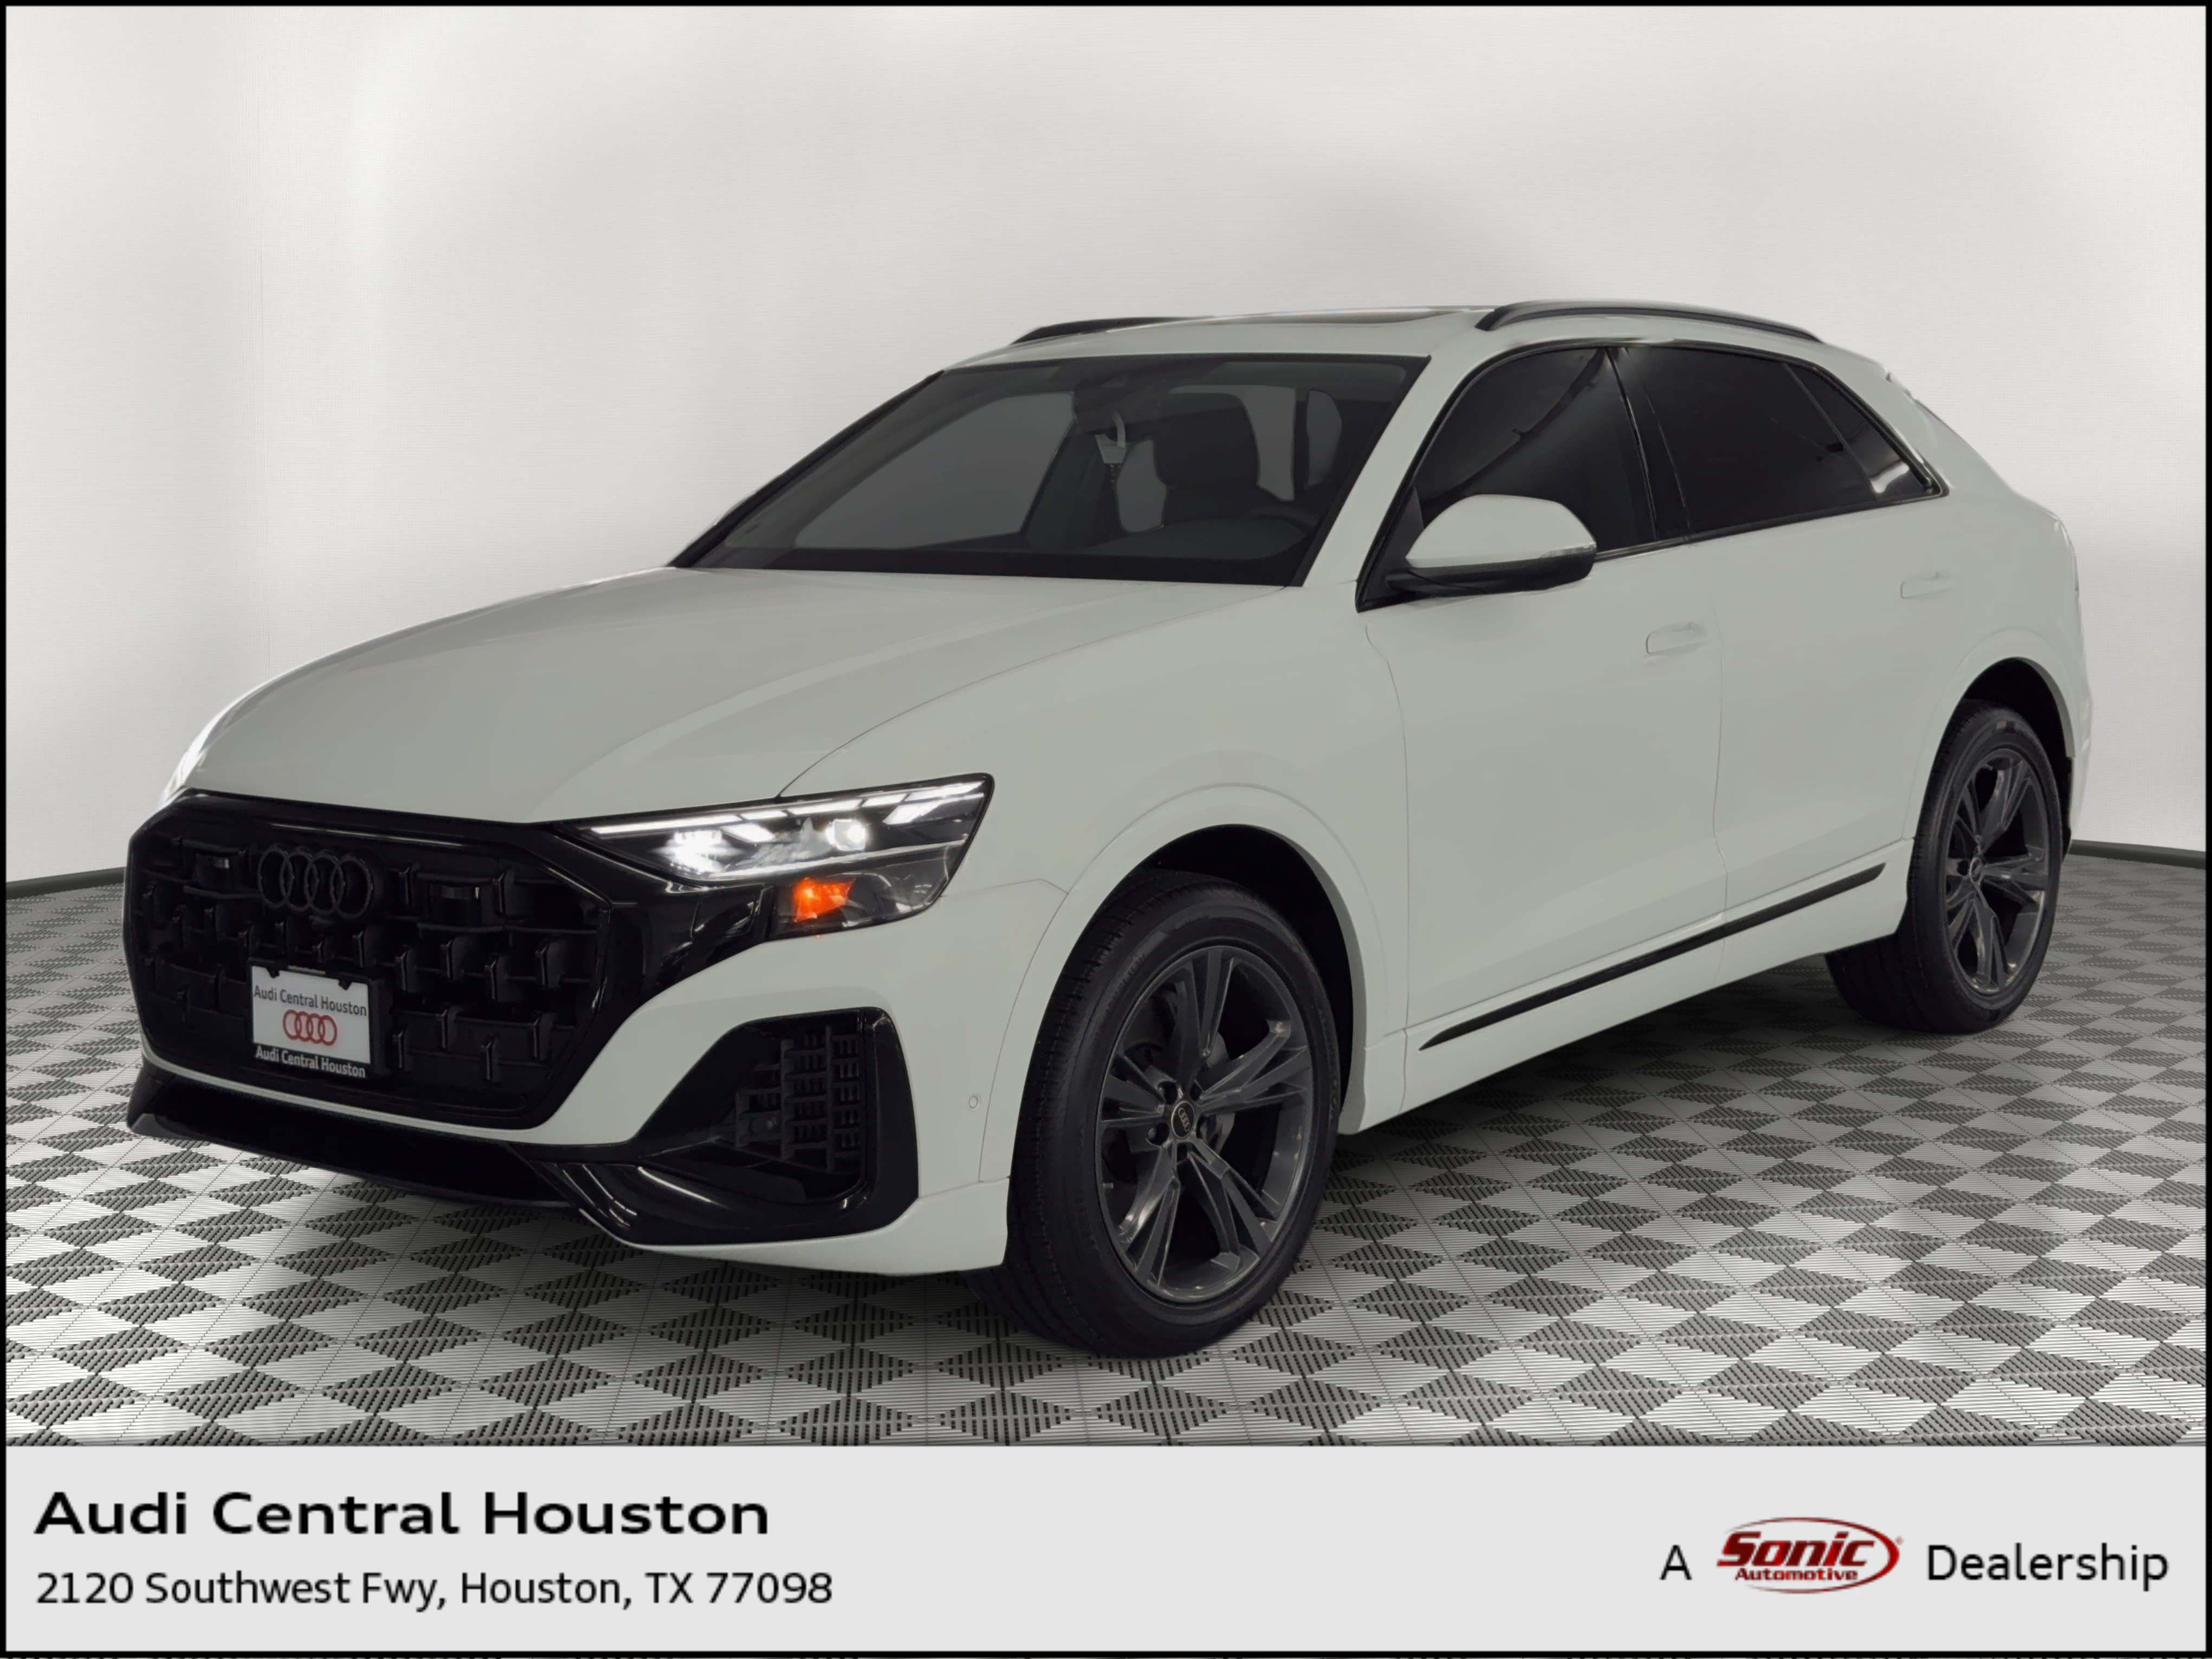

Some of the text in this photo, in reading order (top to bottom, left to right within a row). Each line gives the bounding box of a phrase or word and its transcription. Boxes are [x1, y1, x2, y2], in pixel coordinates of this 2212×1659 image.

[254, 985, 367, 1017] Audi Central Houston
[255, 1045, 366, 1078] Audi Central Houston
